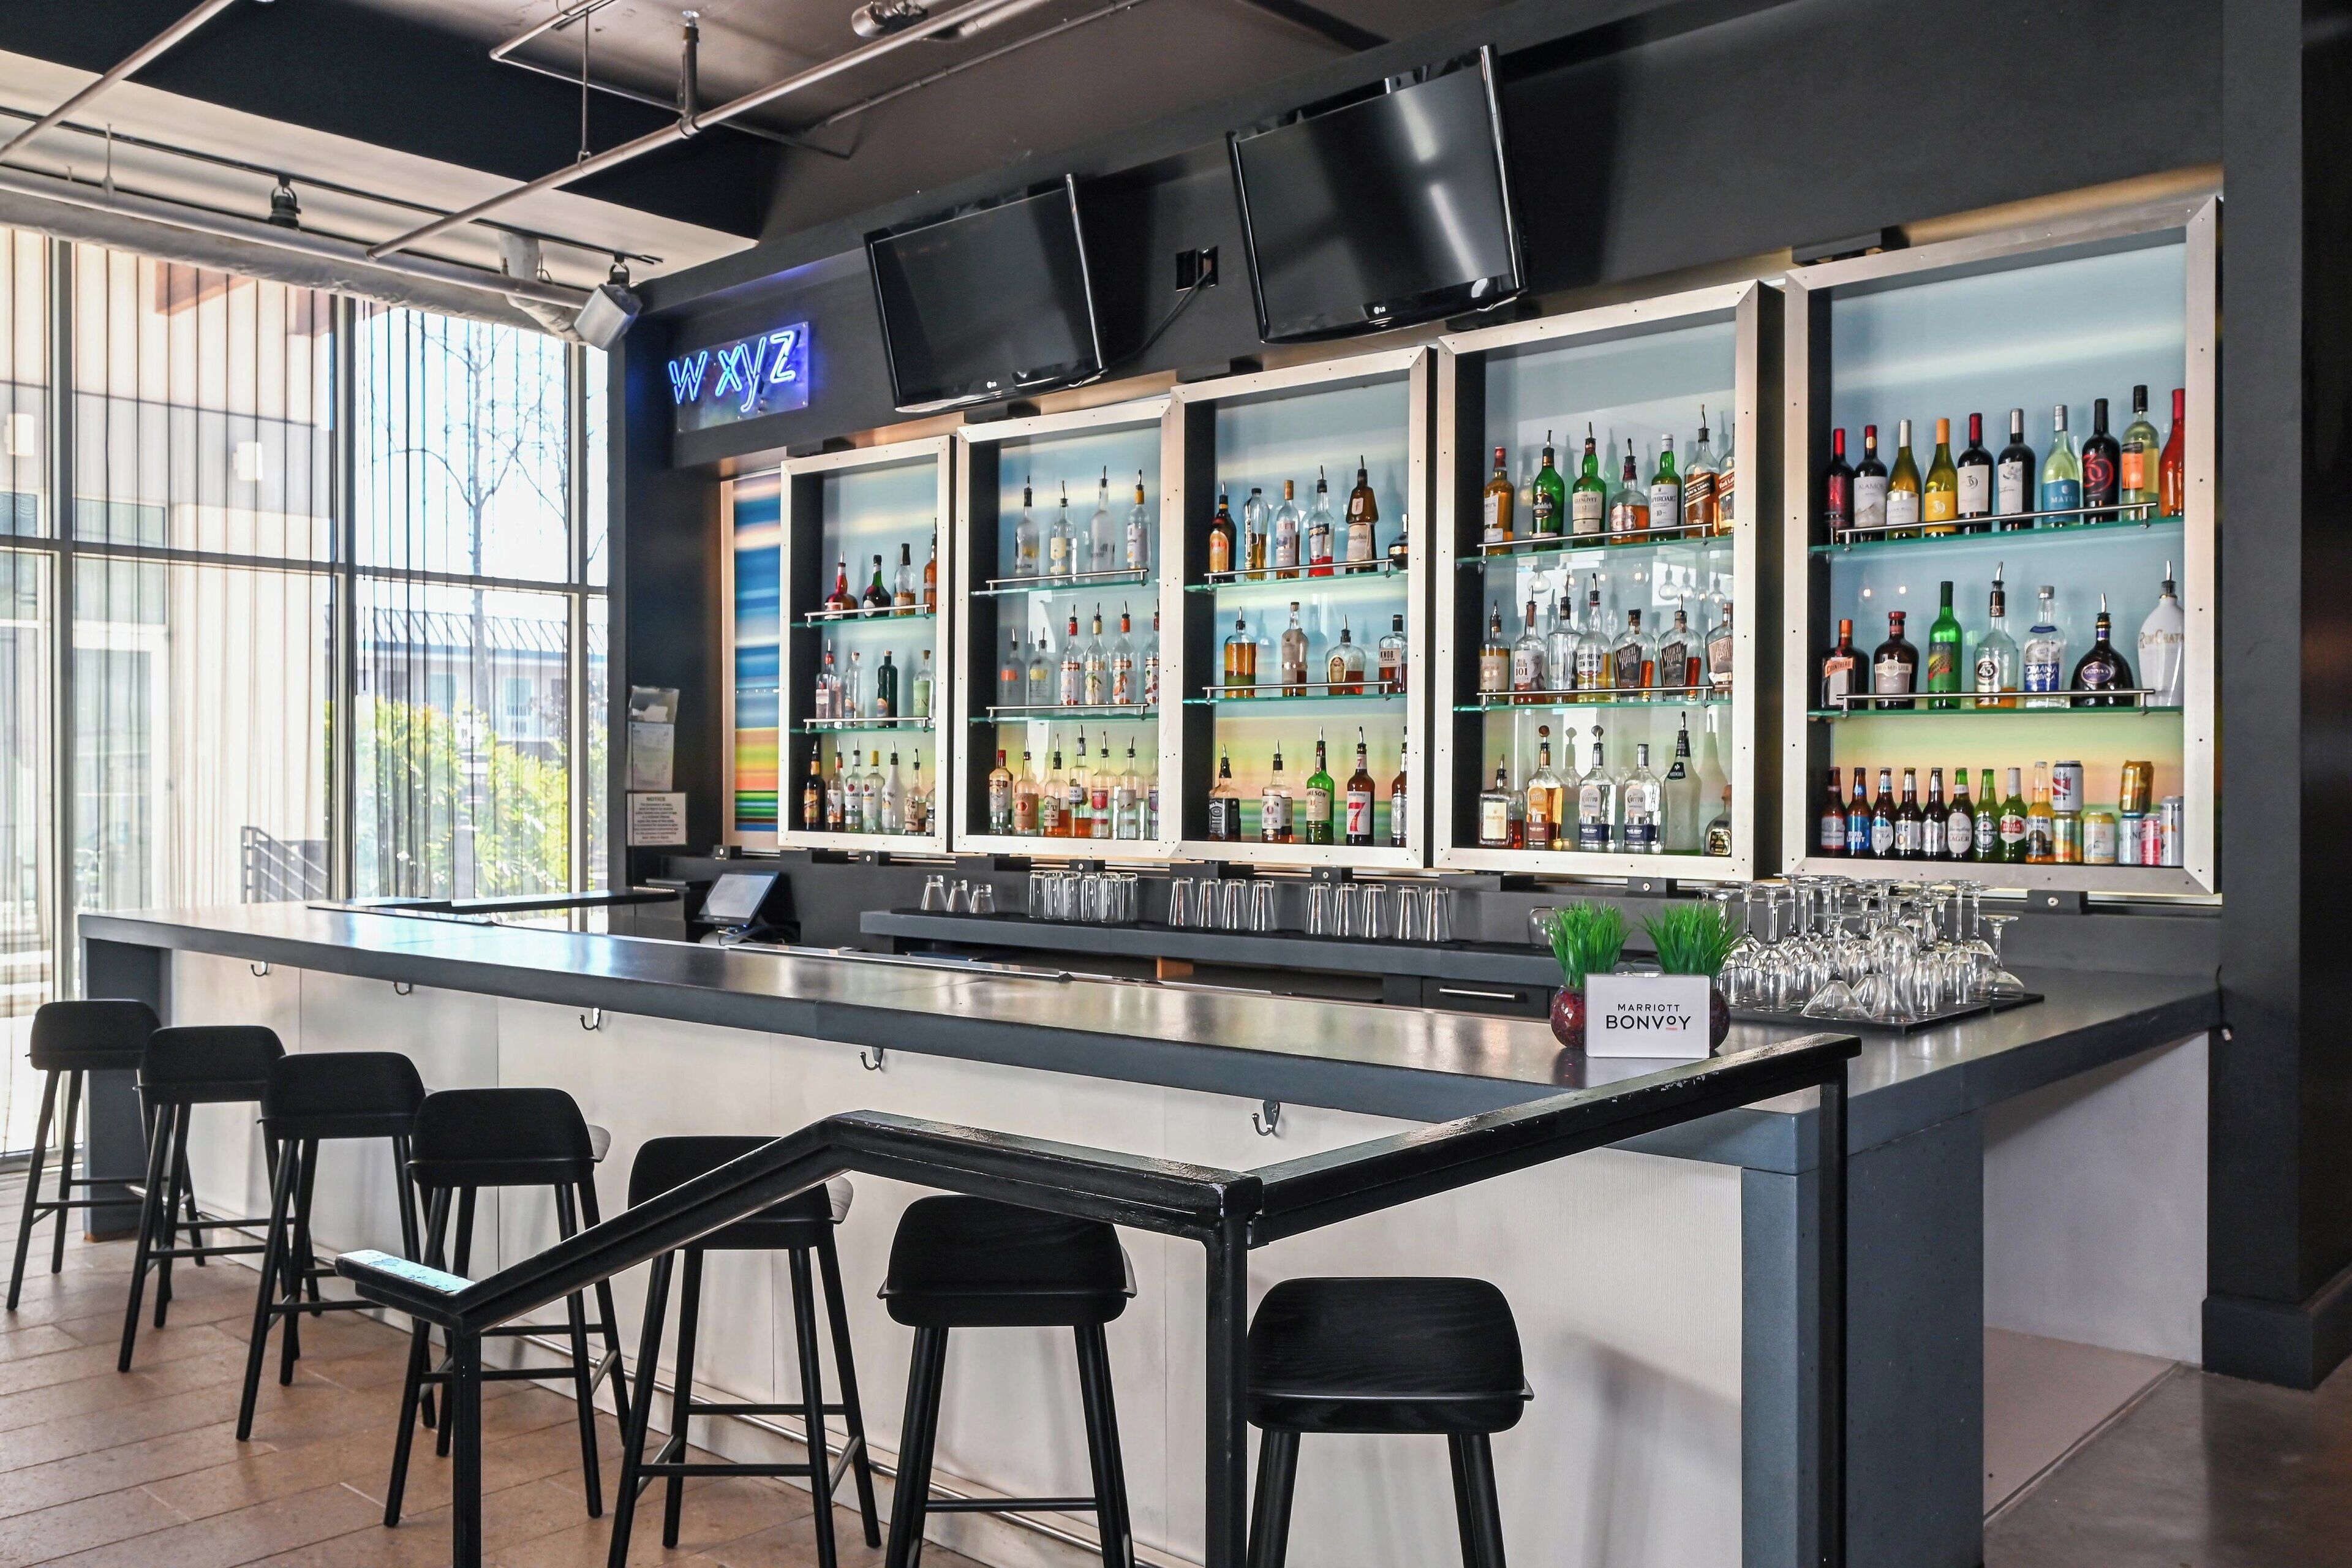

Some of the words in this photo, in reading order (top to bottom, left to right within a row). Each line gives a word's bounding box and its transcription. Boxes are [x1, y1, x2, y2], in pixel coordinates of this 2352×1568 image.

[1978, 663, 1994, 676] 43
[1357, 758, 1363, 767] 7
[1348, 802, 1366, 831] 7
[1606, 1015, 1691, 1030] BONVOY
